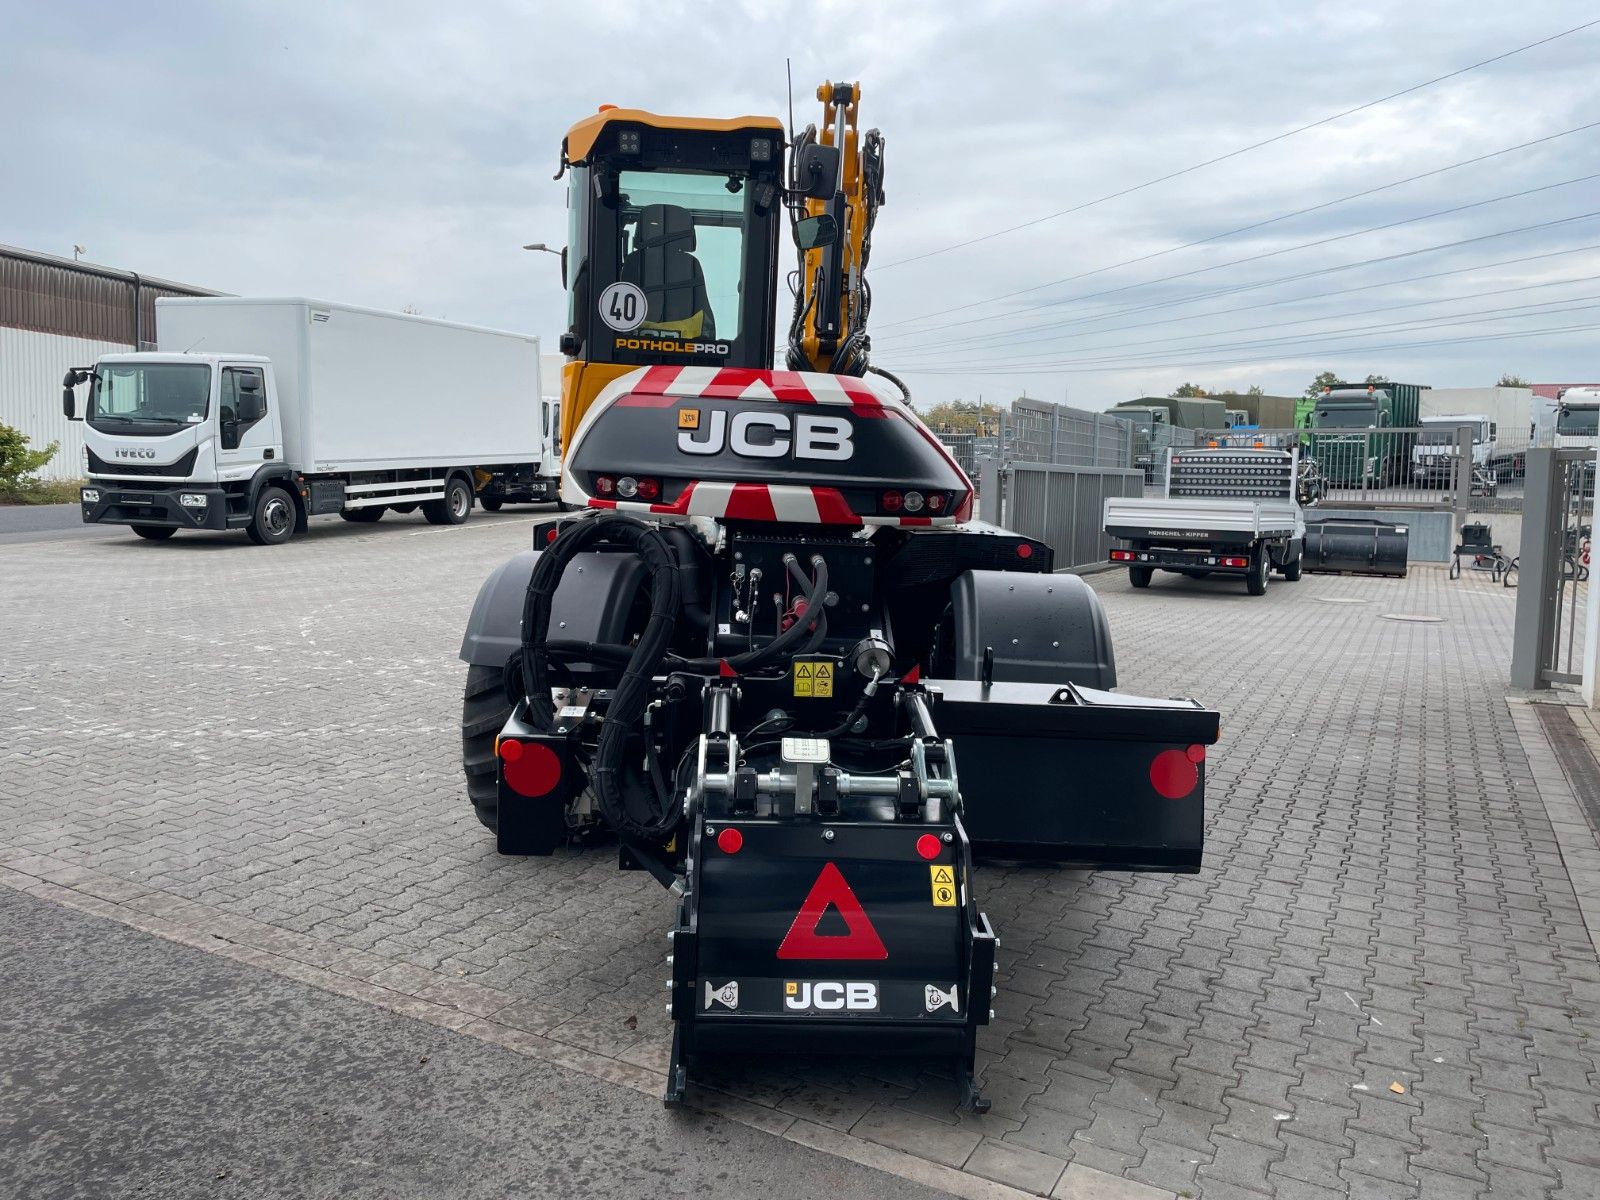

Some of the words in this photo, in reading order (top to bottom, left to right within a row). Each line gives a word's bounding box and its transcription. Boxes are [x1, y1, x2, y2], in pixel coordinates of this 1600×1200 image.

[610, 292, 637, 321] 40
[677, 410, 854, 461] JCB
[115, 448, 155, 458] IVECO
[786, 982, 878, 1009] JCB
